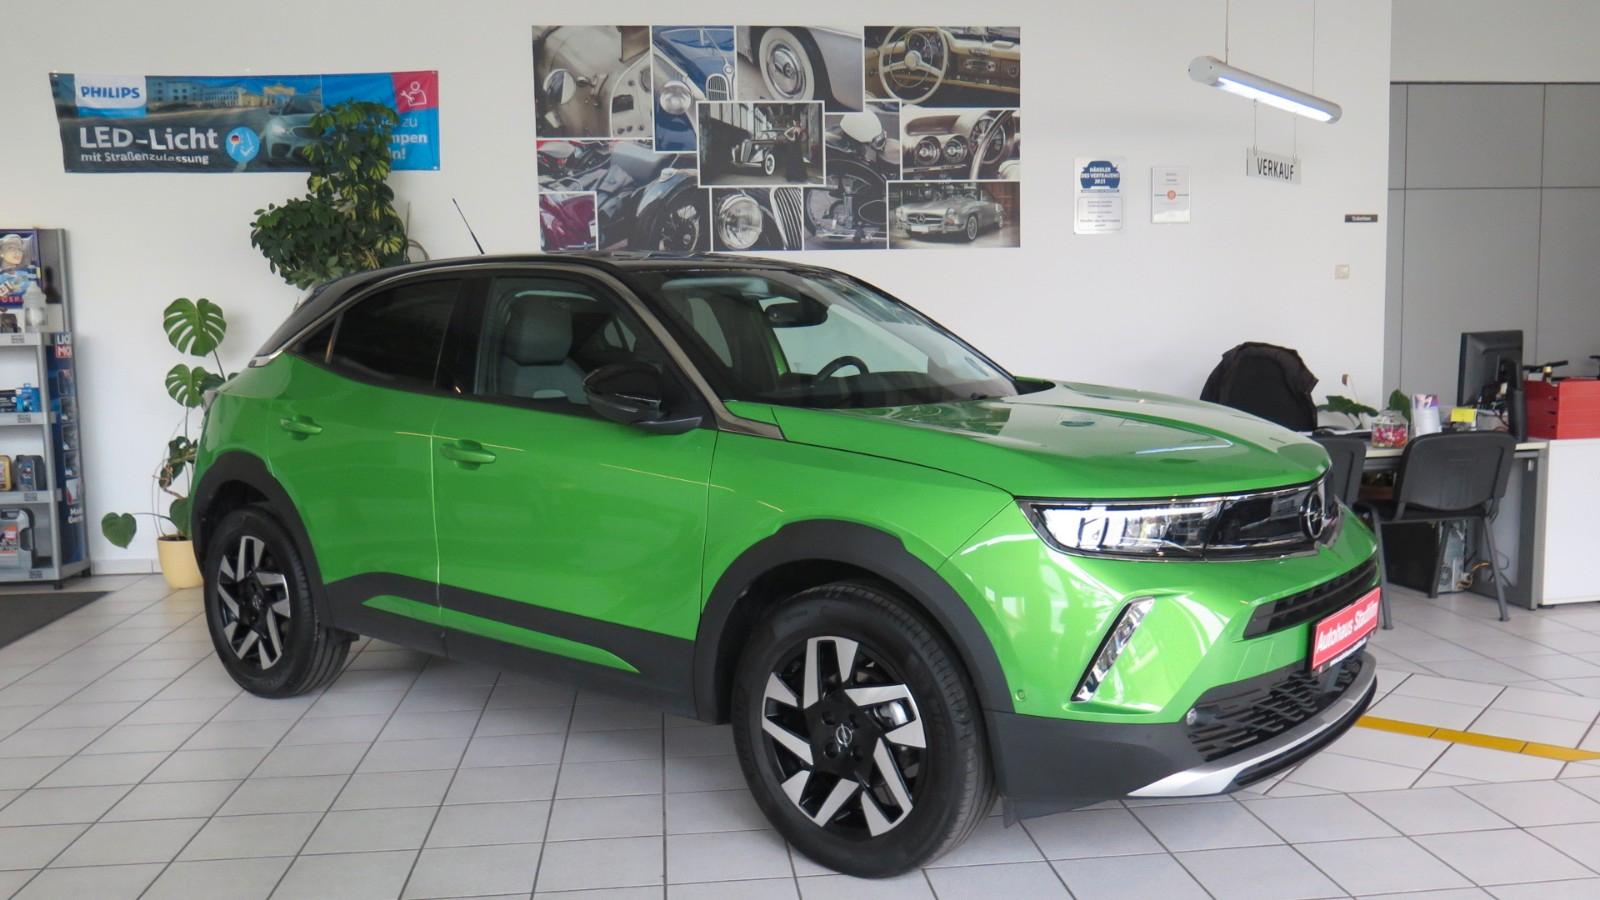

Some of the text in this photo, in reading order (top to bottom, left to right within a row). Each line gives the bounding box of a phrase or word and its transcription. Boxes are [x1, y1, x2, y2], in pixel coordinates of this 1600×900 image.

[81, 86, 140, 99] PHILIPS
[80, 126, 219, 150] LED-Licht
[81, 151, 209, 165] mit Straßenzulassung
[1257, 157, 1294, 181] VERKAUF
[1318, 620, 1353, 651] Autohaus
